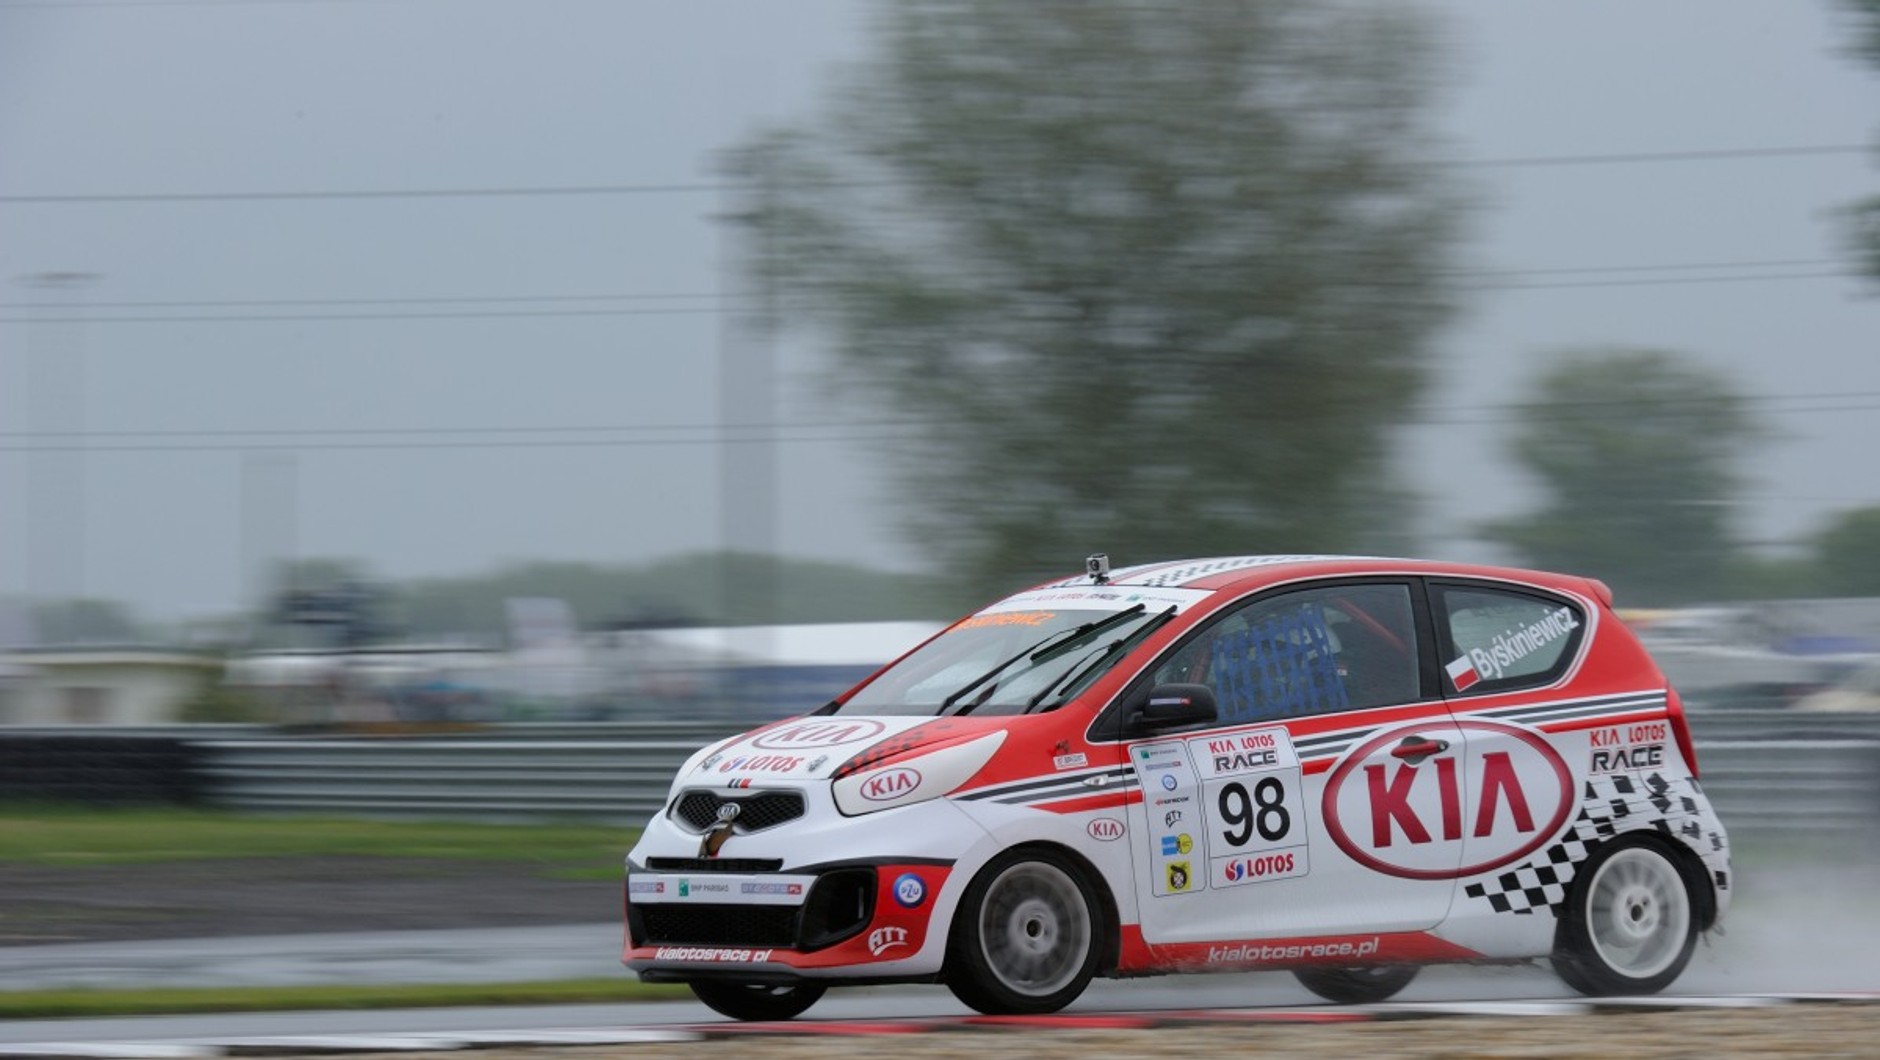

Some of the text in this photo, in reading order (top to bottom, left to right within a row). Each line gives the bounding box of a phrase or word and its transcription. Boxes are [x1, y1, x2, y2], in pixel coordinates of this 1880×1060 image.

[1470, 606, 1579, 679] Byśkiniewicz
[1209, 734, 1275, 754] KIA LOTOS
[1590, 723, 1666, 747] KIA LOTOS
[741, 756, 804, 772] LOTOS
[1214, 750, 1278, 773] RACE
[1592, 745, 1664, 773] RACE
[870, 773, 912, 796] KIA
[1218, 776, 1291, 847] 98
[1363, 752, 1535, 848] KIA
[1093, 822, 1119, 836] KIA
[1247, 853, 1294, 877] LOTOS
[868, 926, 908, 956] ATT
[1208, 937, 1379, 963] kialotosrace.pl
